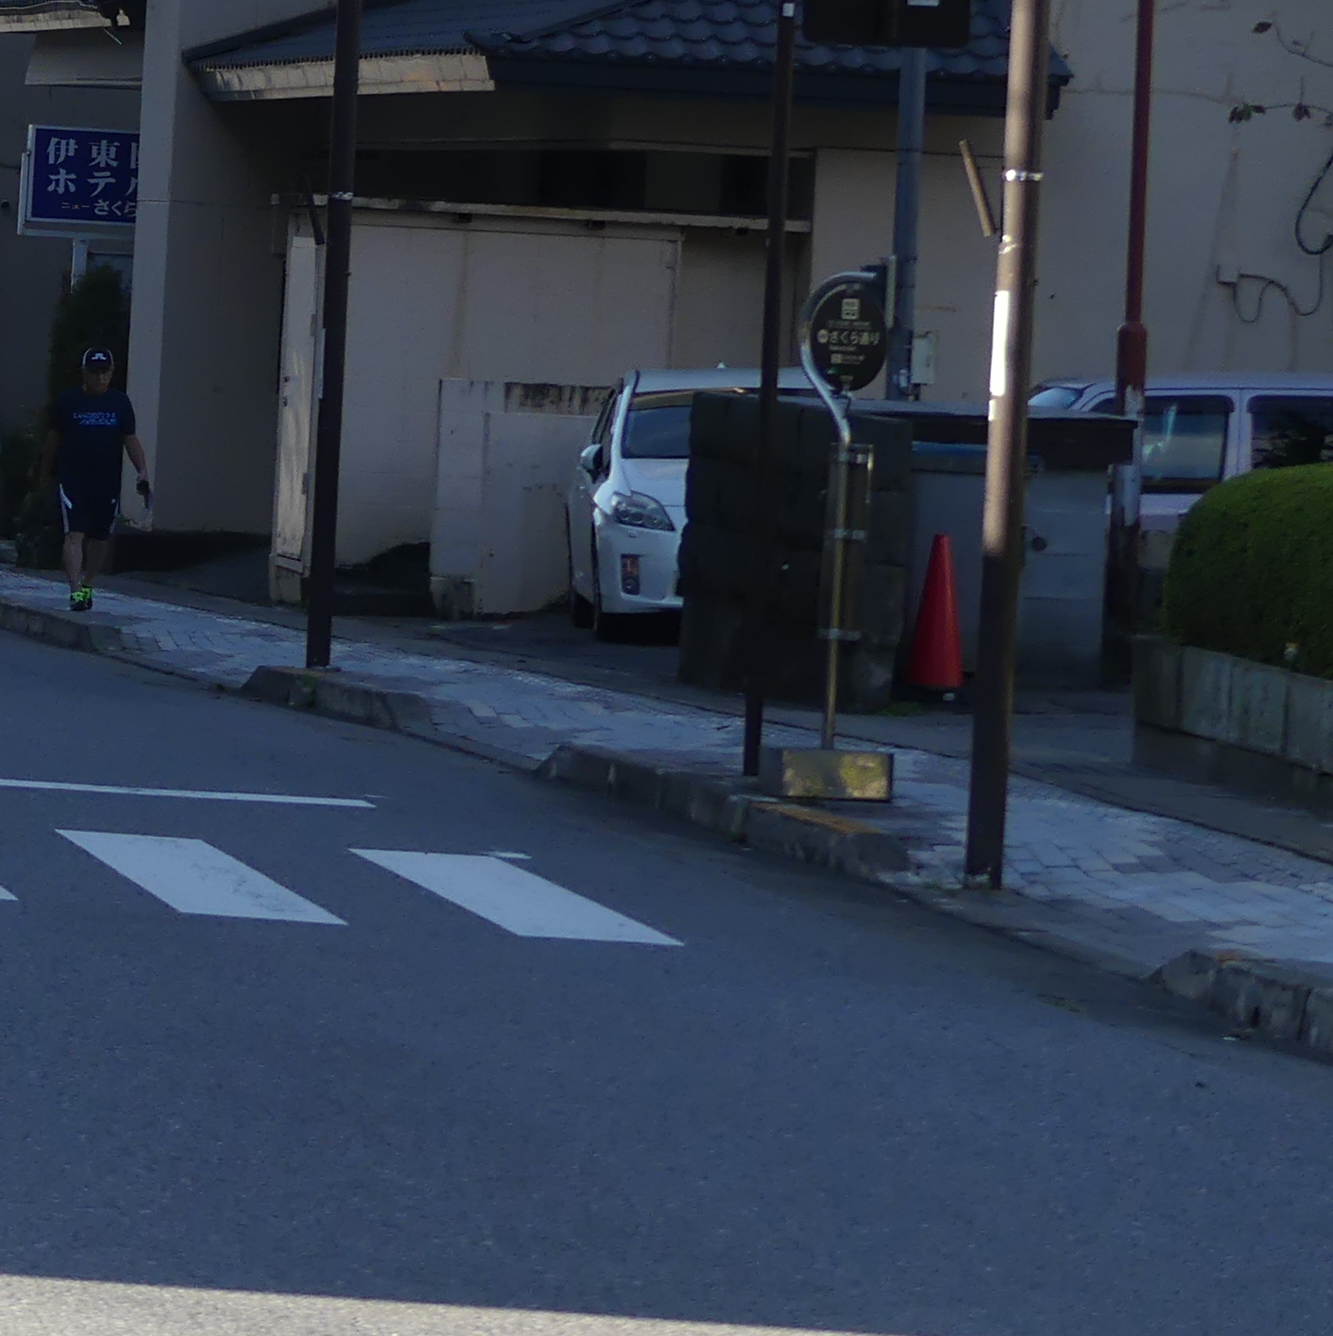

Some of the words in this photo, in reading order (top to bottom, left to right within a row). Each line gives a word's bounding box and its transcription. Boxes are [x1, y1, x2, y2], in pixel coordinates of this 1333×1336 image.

[47, 137, 138, 169] 伊東
[830, 330, 879, 345] さくら通り
